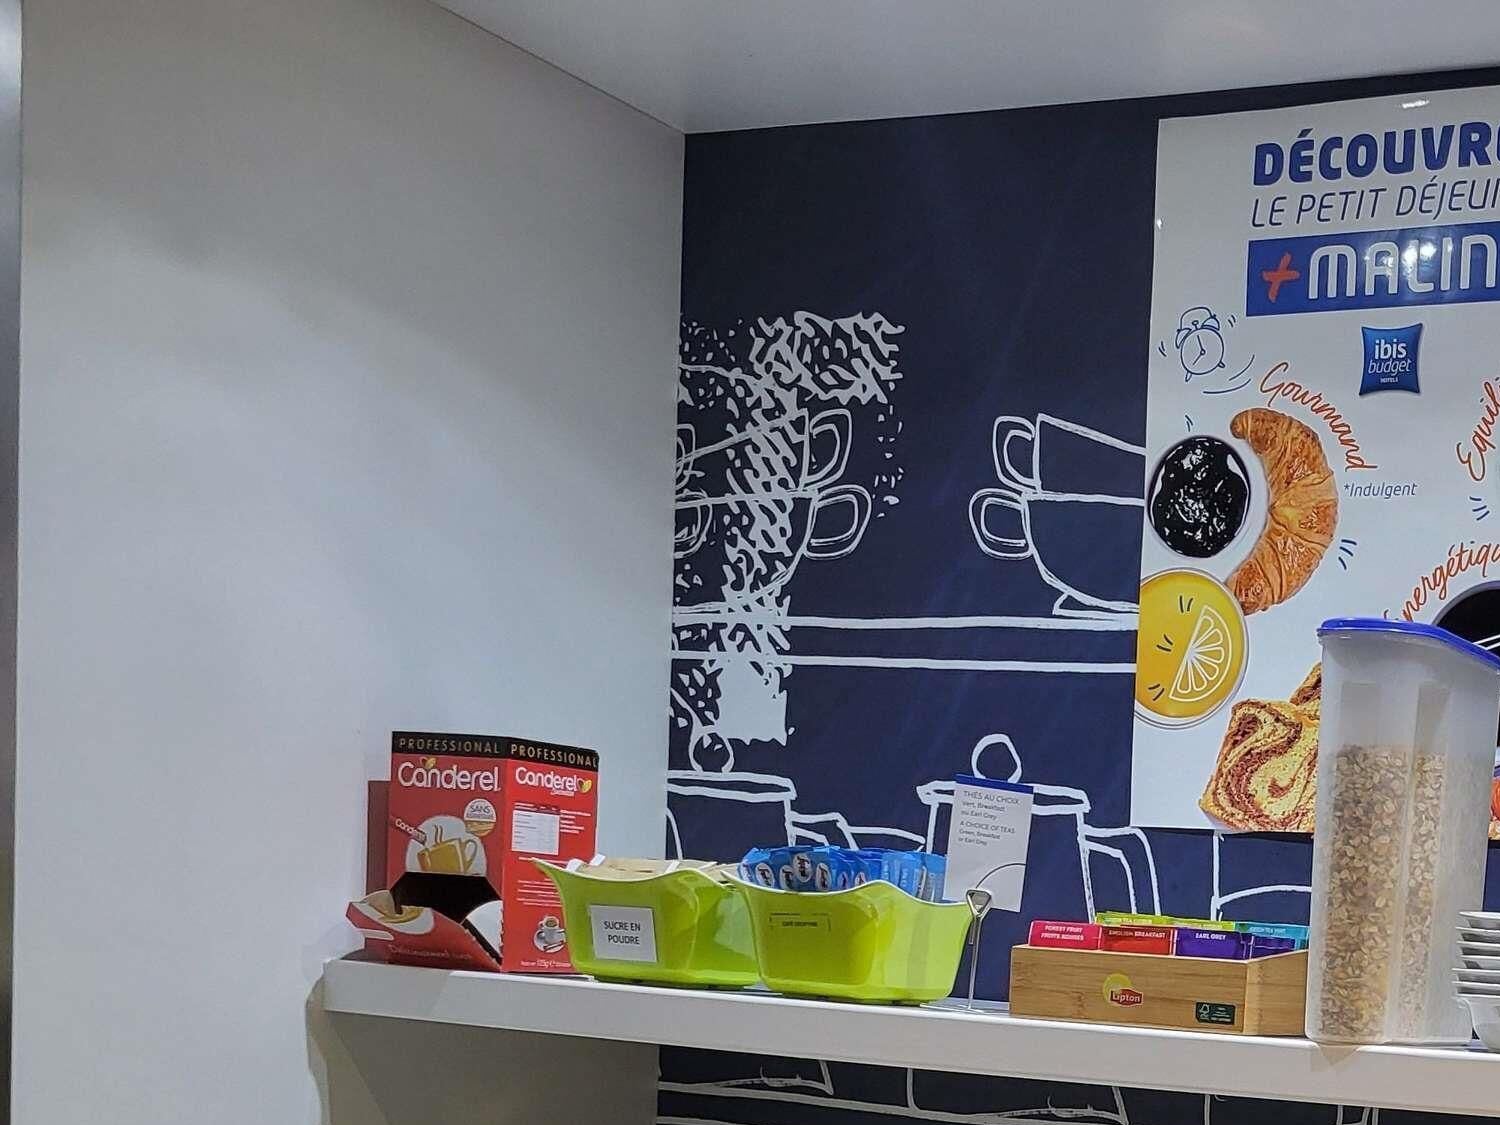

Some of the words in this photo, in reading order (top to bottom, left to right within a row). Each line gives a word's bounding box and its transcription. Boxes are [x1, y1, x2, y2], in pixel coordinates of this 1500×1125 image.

[1251, 196, 1288, 228] LE
[1295, 187, 1388, 225] PETIT
[1308, 233, 1498, 299] MALIN
[1374, 338, 1407, 360] ibis
[1367, 357, 1412, 377] budget
[1258, 361, 1378, 473] Gourmand
[399, 737, 500, 755] PROFESSIONAL
[510, 742, 600, 769] PROFESSIONAL
[397, 760, 501, 792] Canderel
[515, 765, 578, 793] Canderel
[603, 920, 629, 932] SUCRE
[629, 921, 641, 932] EN
[607, 934, 641, 946] POUDRE
[1112, 990, 1141, 1004] Lipton
